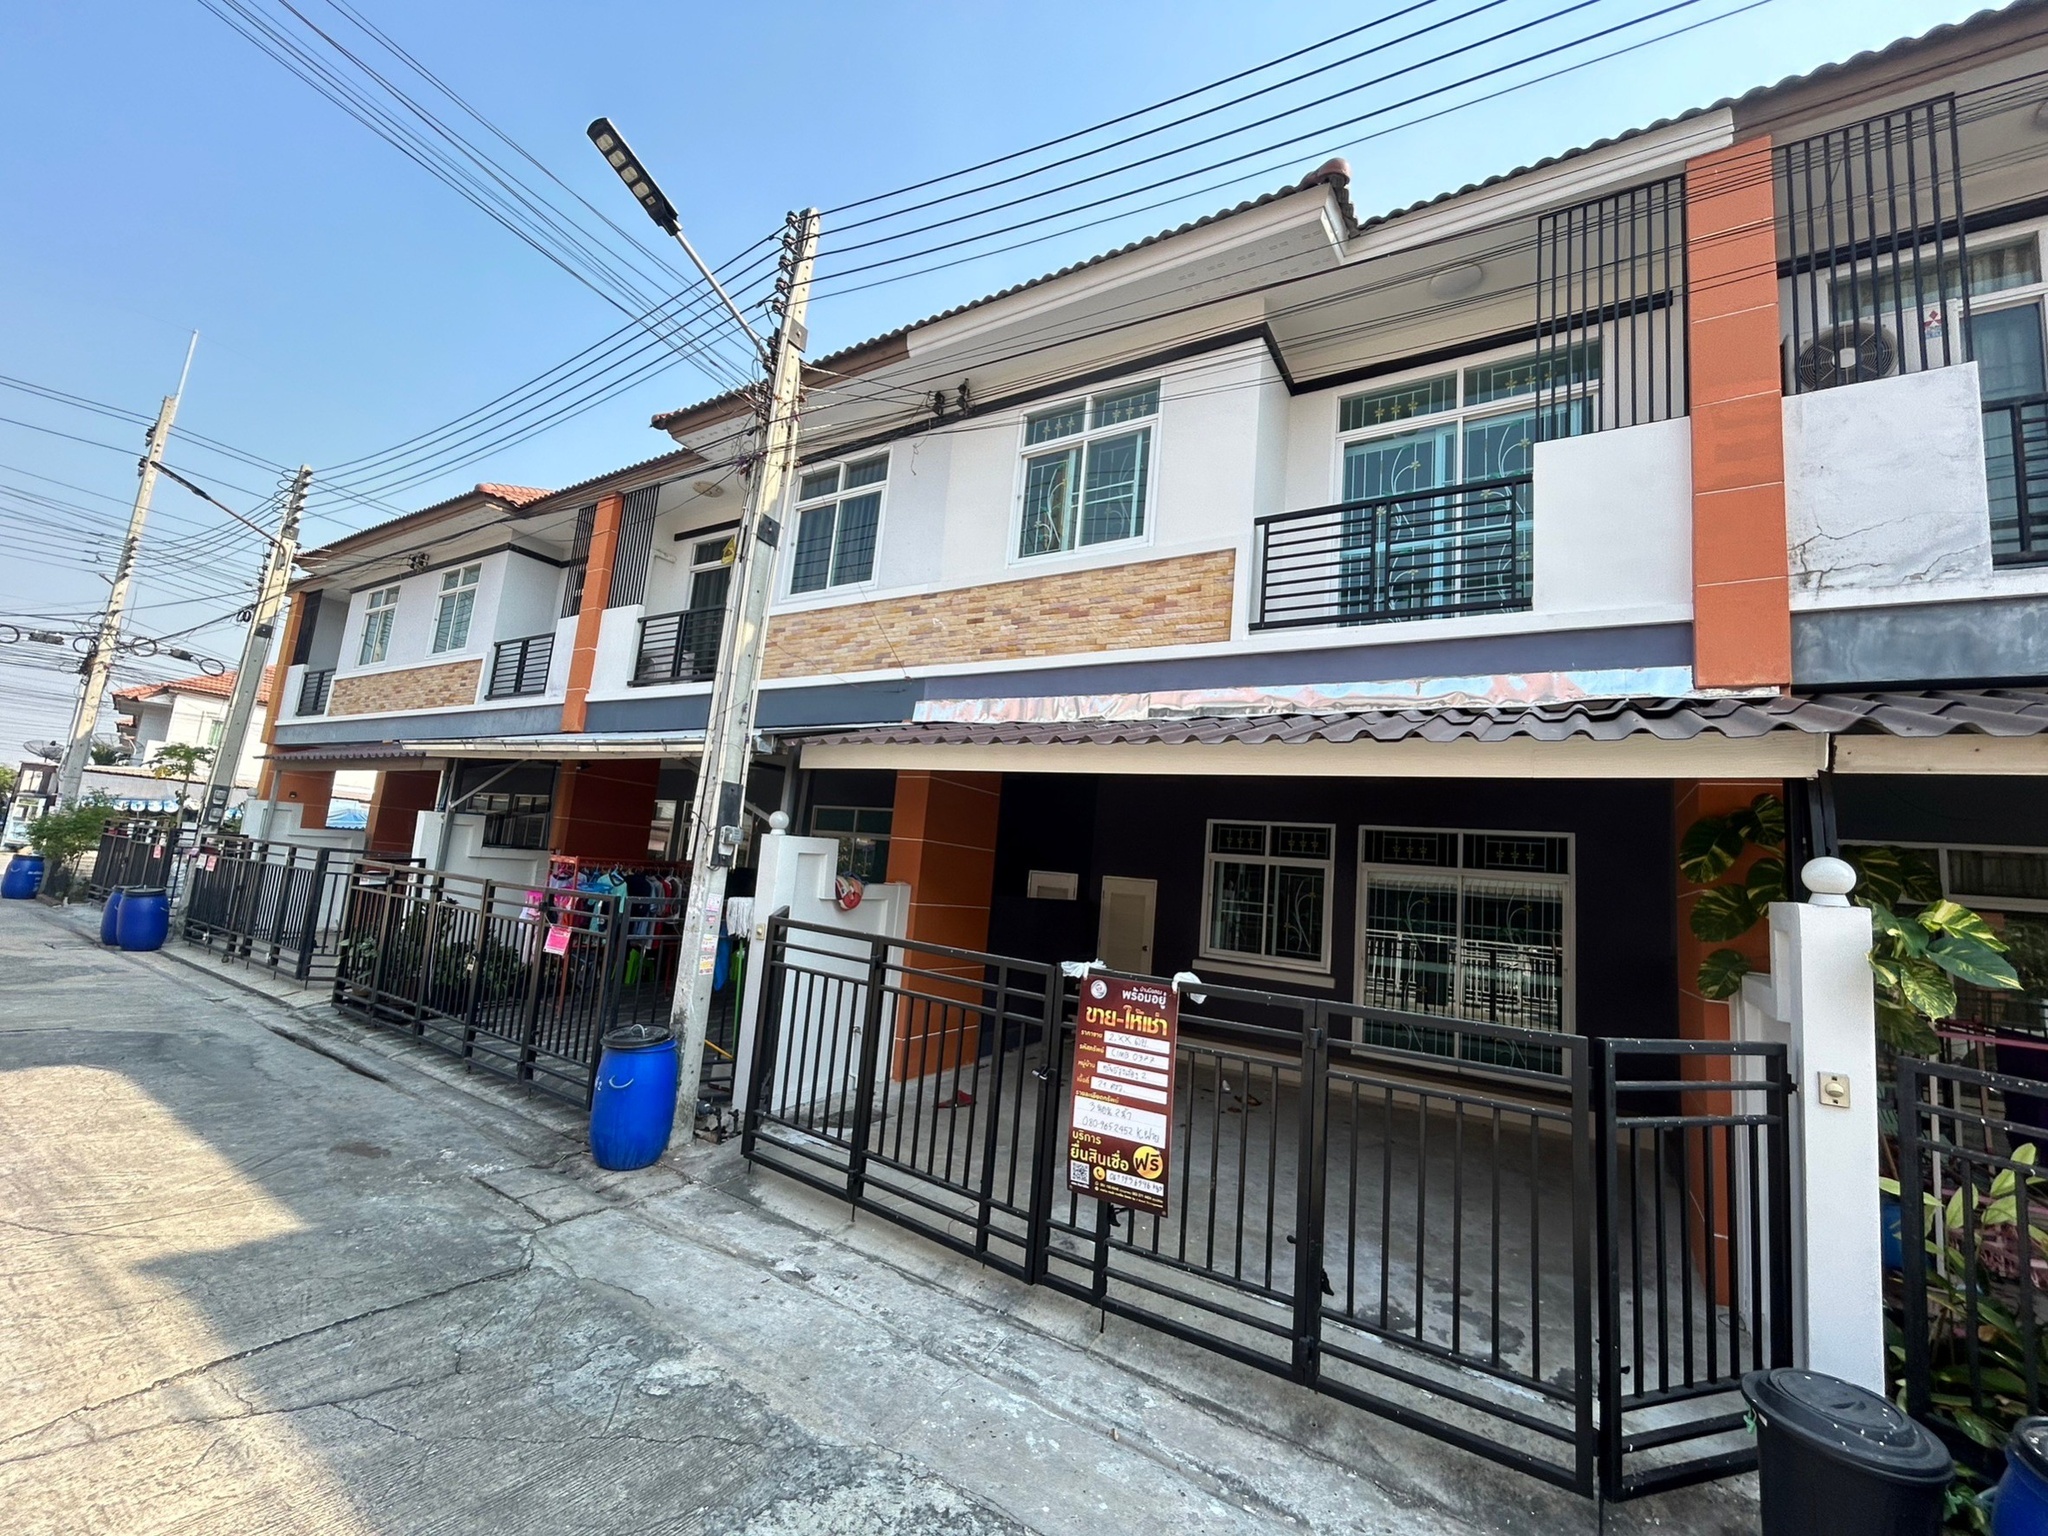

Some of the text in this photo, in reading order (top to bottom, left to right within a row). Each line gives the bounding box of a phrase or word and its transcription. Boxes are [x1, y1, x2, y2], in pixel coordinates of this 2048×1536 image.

[1122, 987, 1167, 1010] พร้อมอยู่
[1086, 1005, 1168, 1036] ขาย-ให้เช่า
[1072, 1129, 1102, 1146] บริการ
[1070, 1140, 1129, 1172] ยื่นสินเชื่อ
[1134, 1152, 1160, 1172] ฟรี
